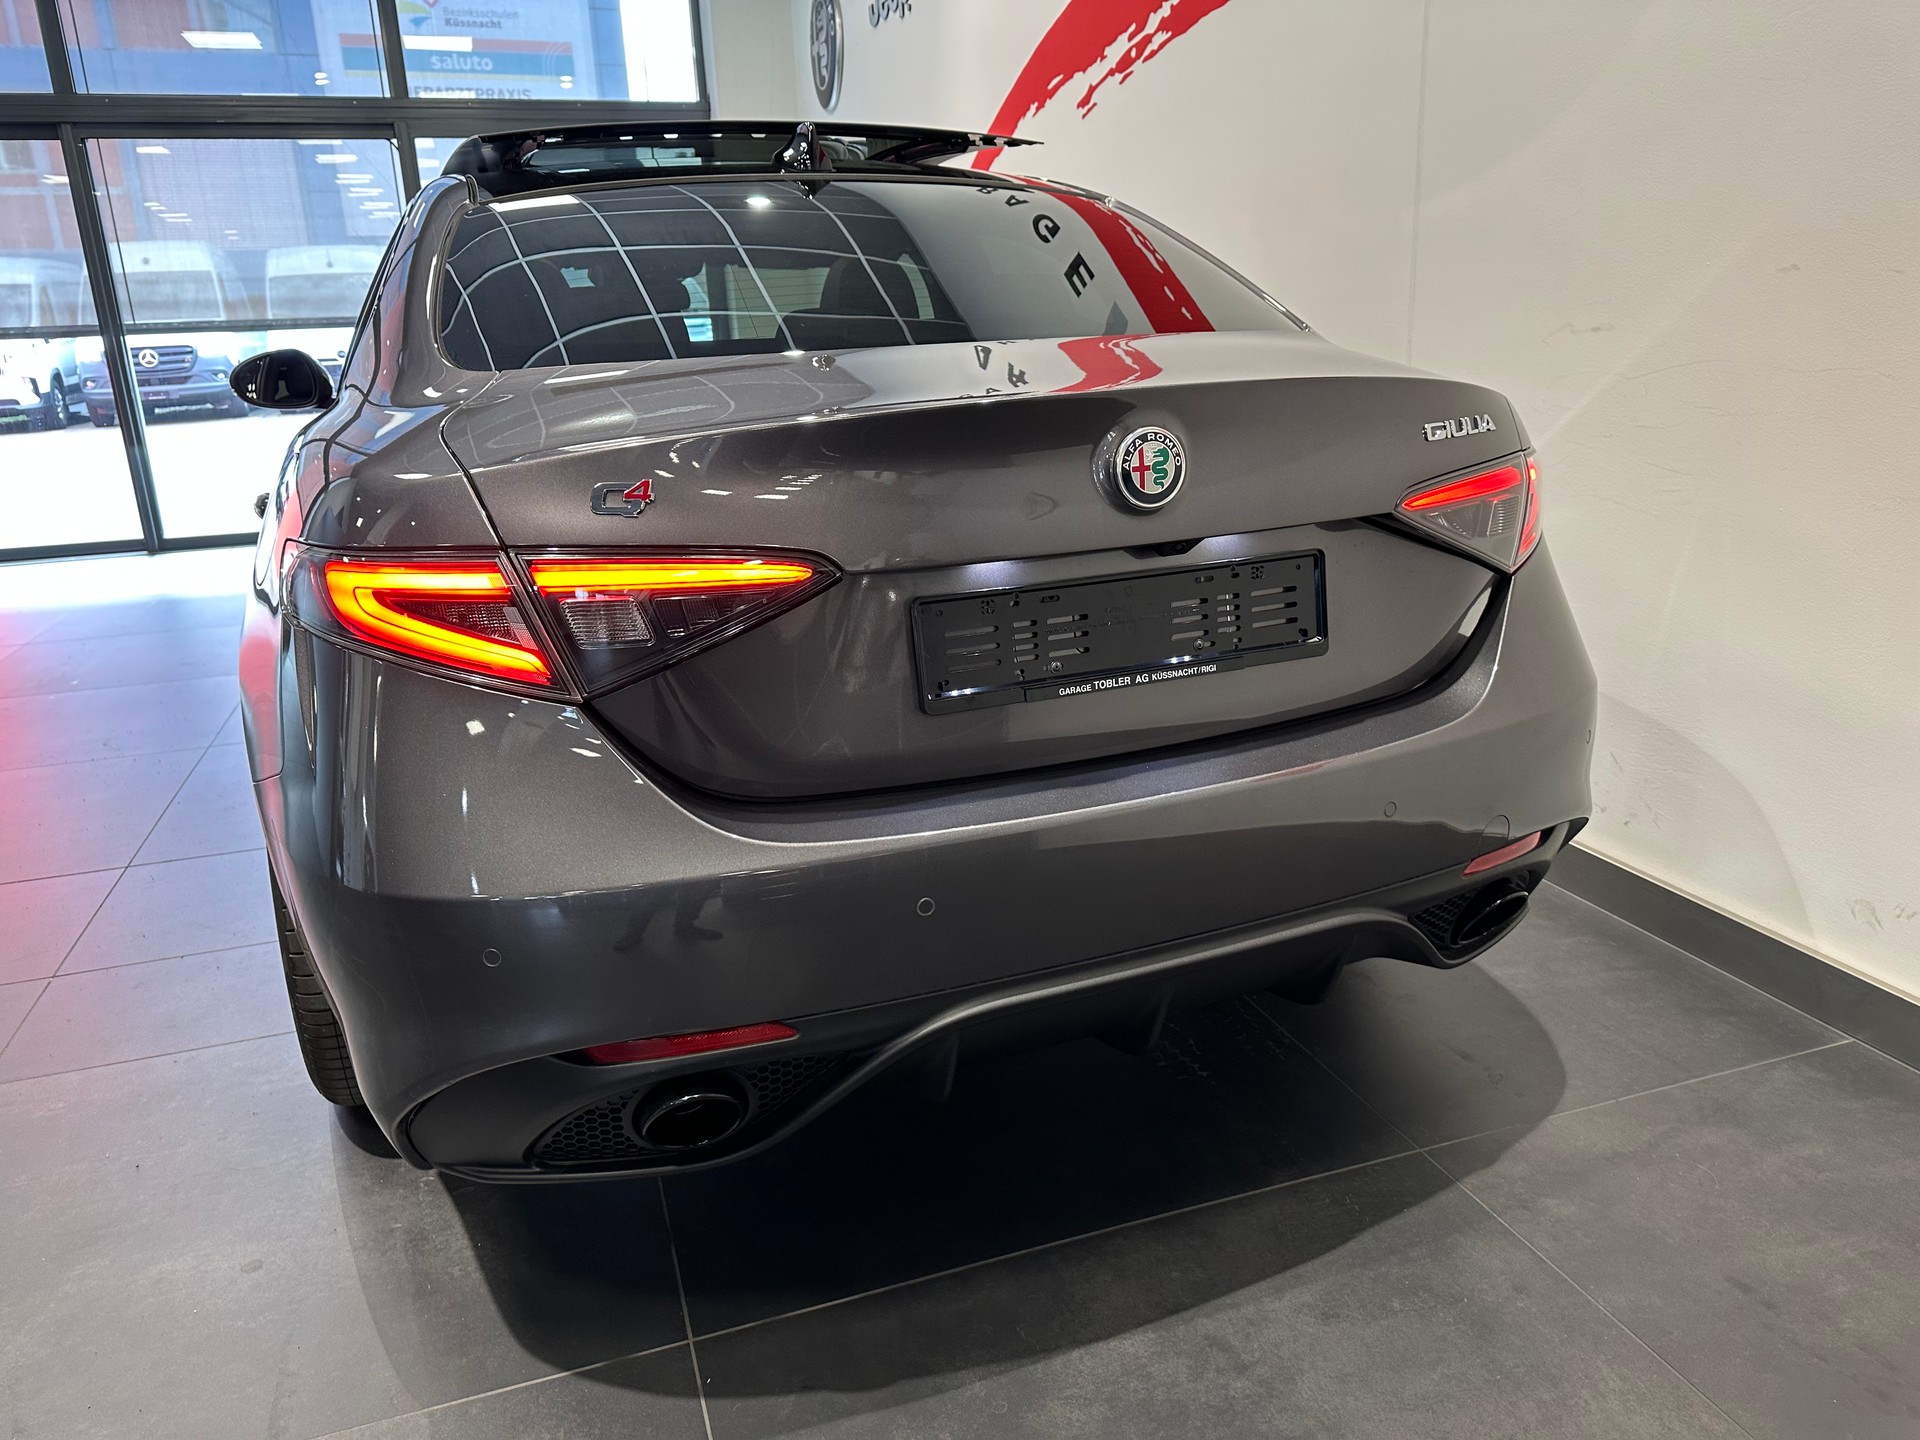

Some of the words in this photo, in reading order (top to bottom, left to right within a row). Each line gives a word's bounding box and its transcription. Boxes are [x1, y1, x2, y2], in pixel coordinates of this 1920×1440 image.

[442, 6, 519, 19] Bezirksschulen
[444, 17, 503, 29] Küssnacht
[430, 53, 493, 71] saluto
[1422, 413, 1497, 441] GIULIA
[1123, 438, 1143, 470] ALFA
[1147, 432, 1181, 466] ROMEO
[590, 479, 656, 518] Q4
[1058, 683, 1092, 696] GARAGE
[1093, 676, 1131, 690] TOBLER
[1135, 673, 1149, 684] AG
